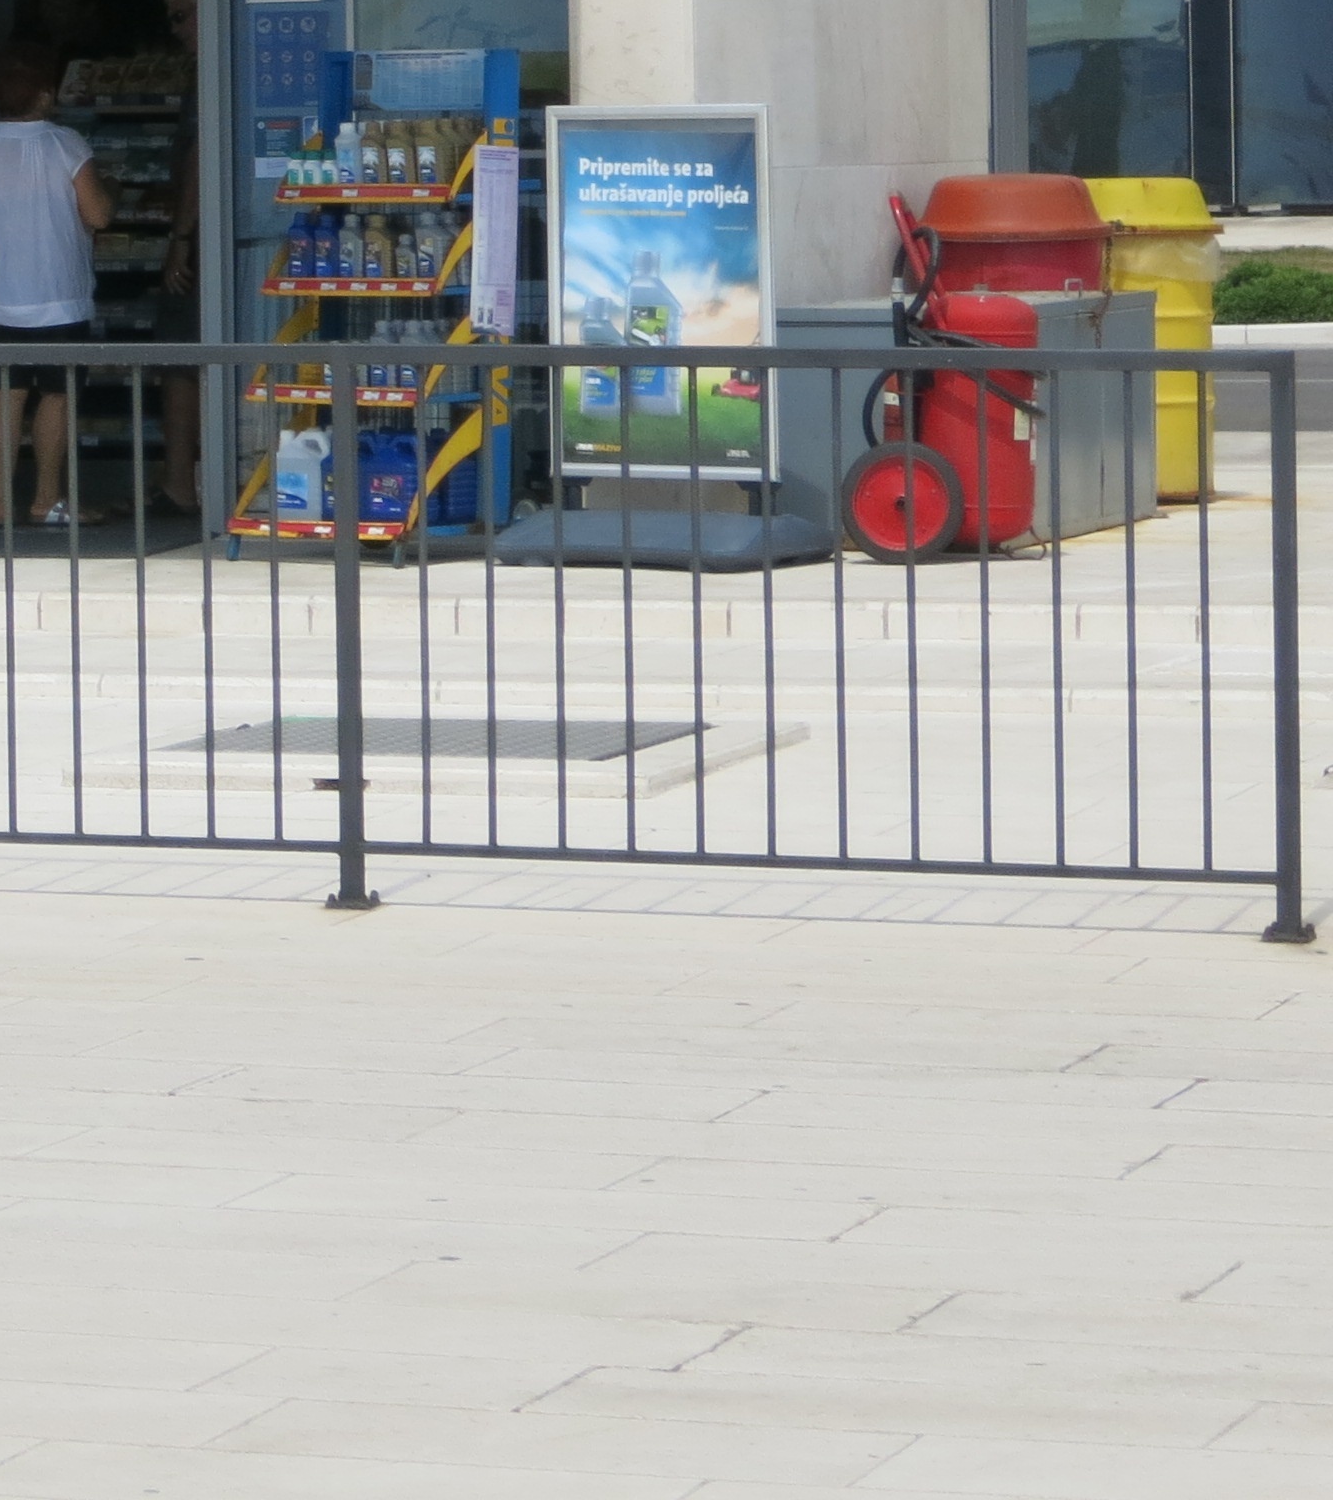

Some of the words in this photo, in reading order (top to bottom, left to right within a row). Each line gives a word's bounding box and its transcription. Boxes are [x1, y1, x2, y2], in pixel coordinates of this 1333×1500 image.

[579, 157, 670, 180] Pripremite
[674, 163, 692, 177] se
[696, 163, 714, 177] za
[579, 183, 683, 208] ukrašavanje
[687, 184, 749, 209] proljeća
